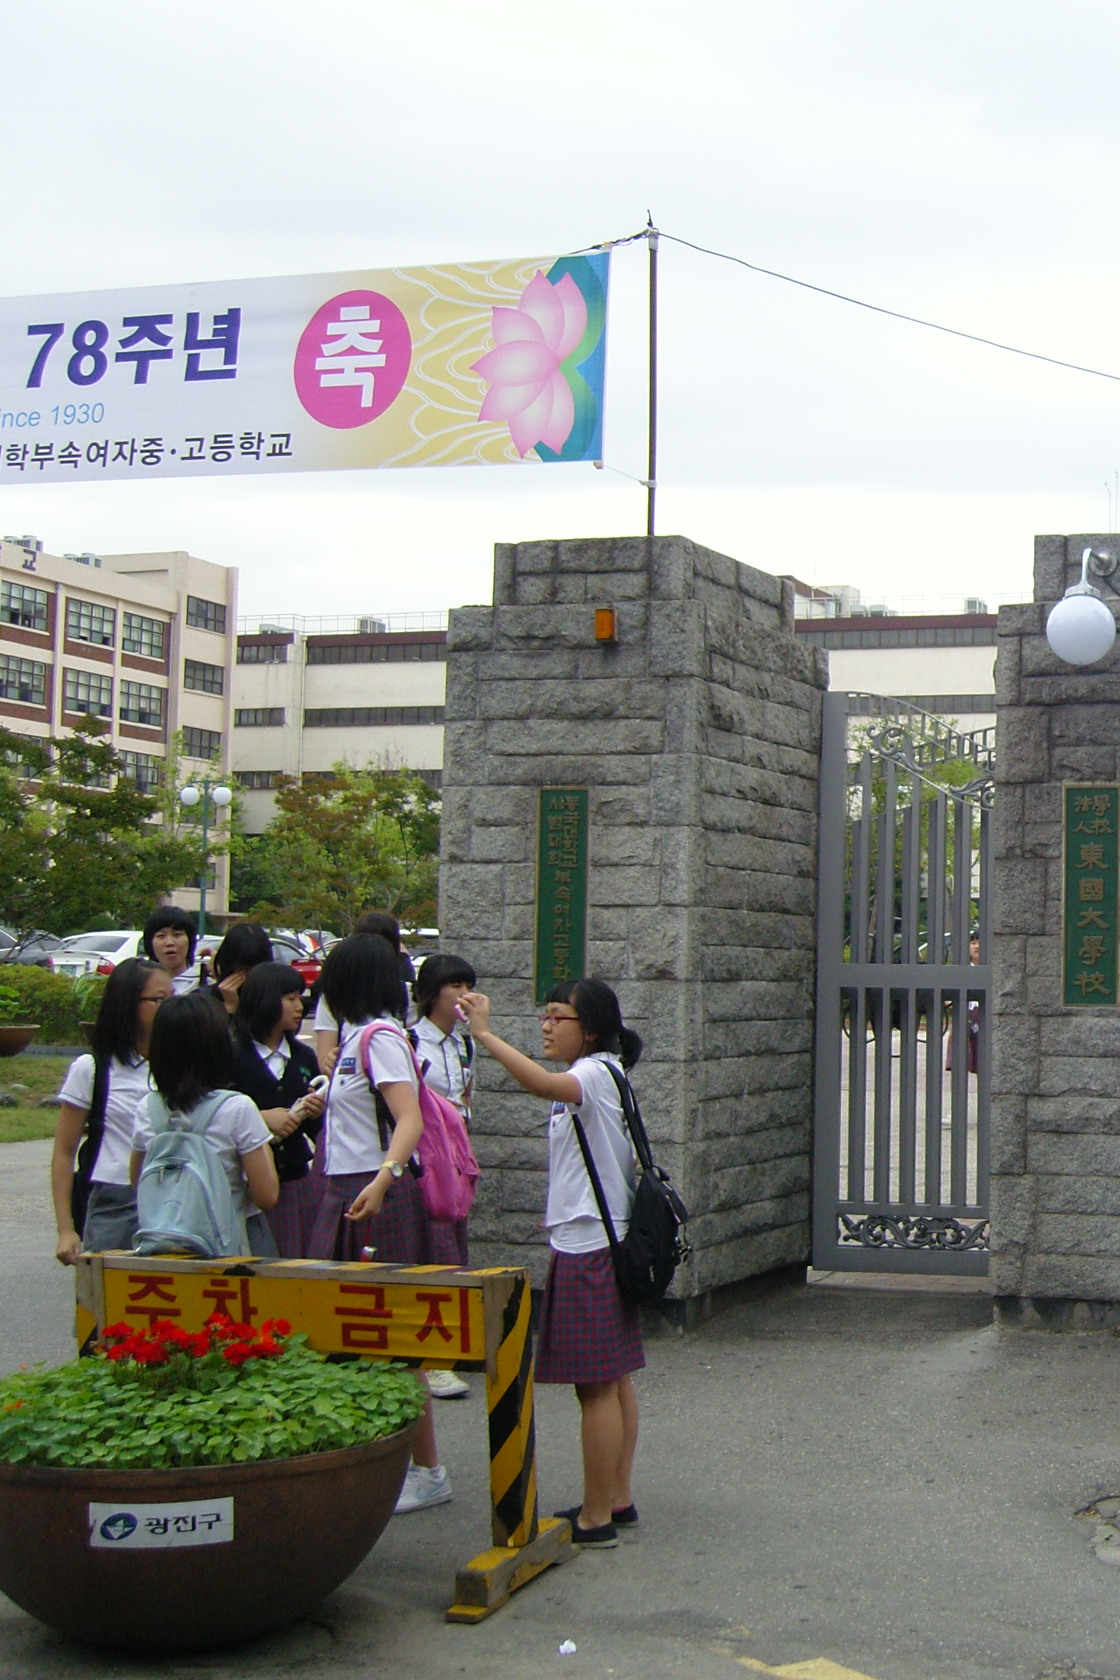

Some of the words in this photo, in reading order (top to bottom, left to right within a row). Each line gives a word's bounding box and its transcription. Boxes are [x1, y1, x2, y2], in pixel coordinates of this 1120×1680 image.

[25, 306, 242, 390] 78주년
[314, 304, 388, 409] 축
[0, 410, 41, 428] nce
[50, 402, 105, 426] 1930
[0, 430, 293, 472] 학부속여자중·고등학교
[552, 871, 572, 981] 부속여자고등학
[1072, 841, 1112, 998] 東國大學校
[124, 1274, 258, 1329] 주차
[334, 1284, 471, 1354] 금지
[144, 1512, 224, 1536] 광진구
